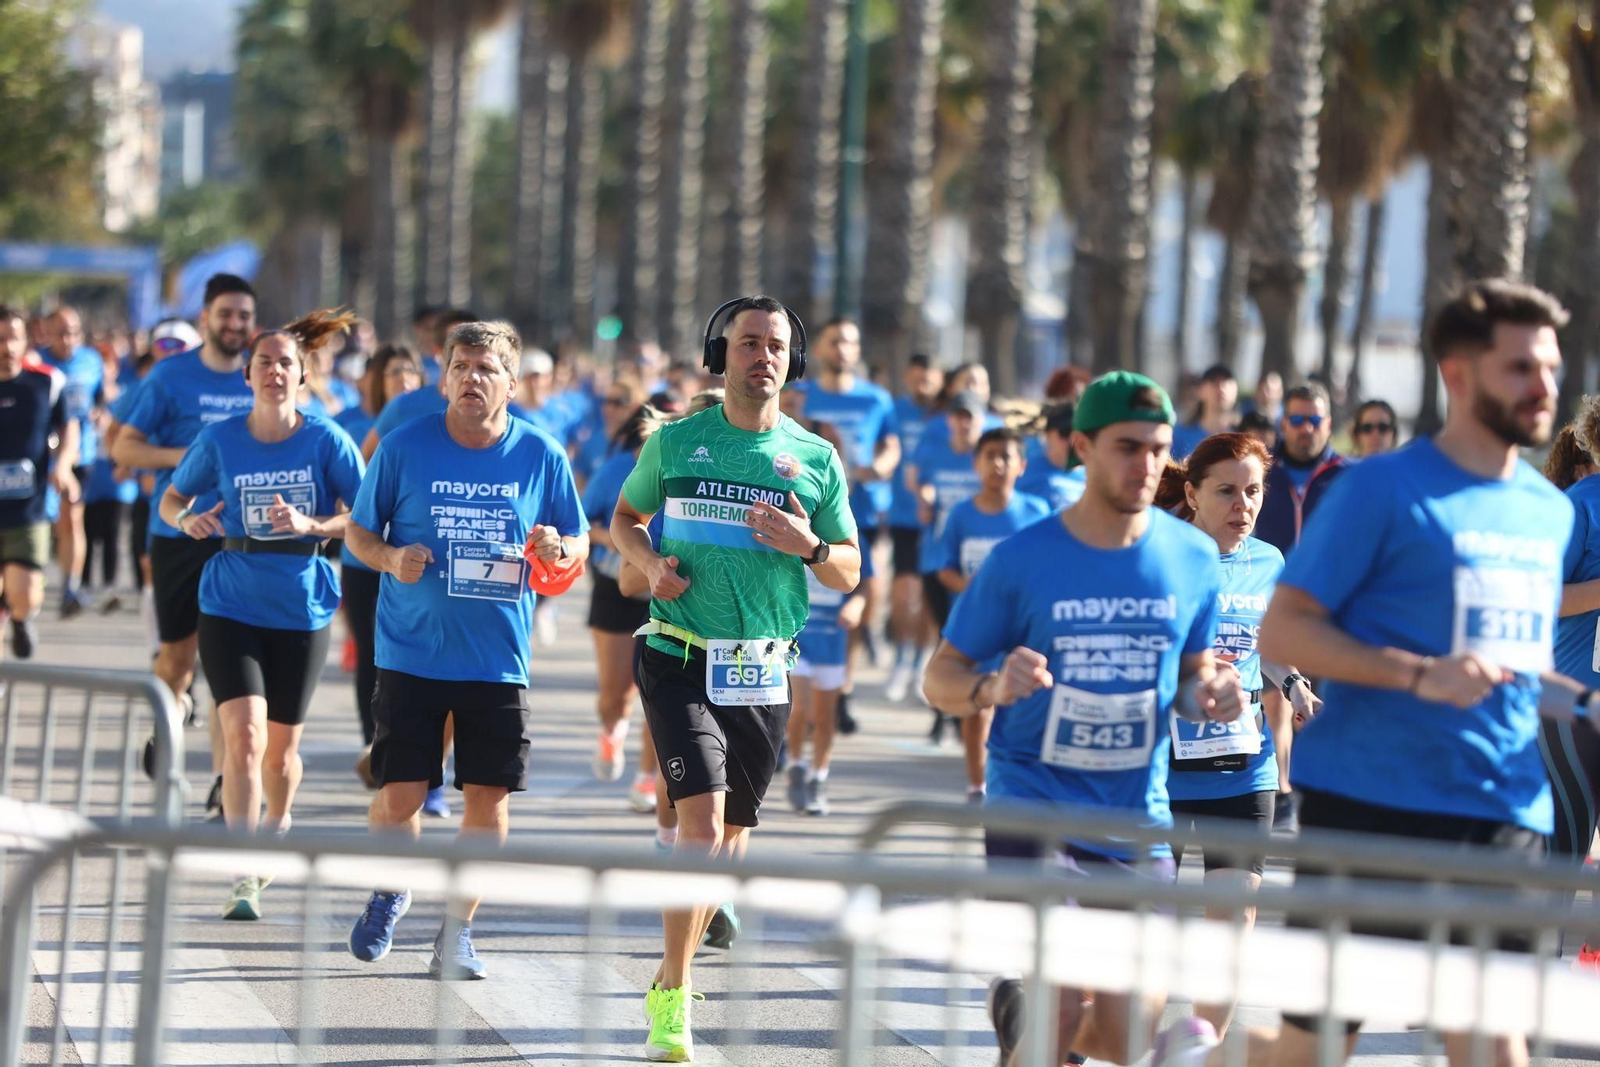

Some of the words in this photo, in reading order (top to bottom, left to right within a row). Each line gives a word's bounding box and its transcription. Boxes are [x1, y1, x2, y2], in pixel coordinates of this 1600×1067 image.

[234, 465, 312, 488] mayoral
[431, 481, 520, 500] mayoral
[696, 481, 785, 507] ATLETISMO
[431, 506, 514, 520] RUNNING
[438, 518, 507, 531] MAKES
[437, 529, 507, 542] FRIENDS
[483, 563, 494, 579] 7
[1052, 595, 1176, 623] mayoral
[1217, 593, 1268, 613] yoral
[1480, 608, 1533, 640] 311
[1212, 635, 1258, 650] AKES
[726, 668, 772, 686] 692
[1072, 724, 1133, 748] 543
